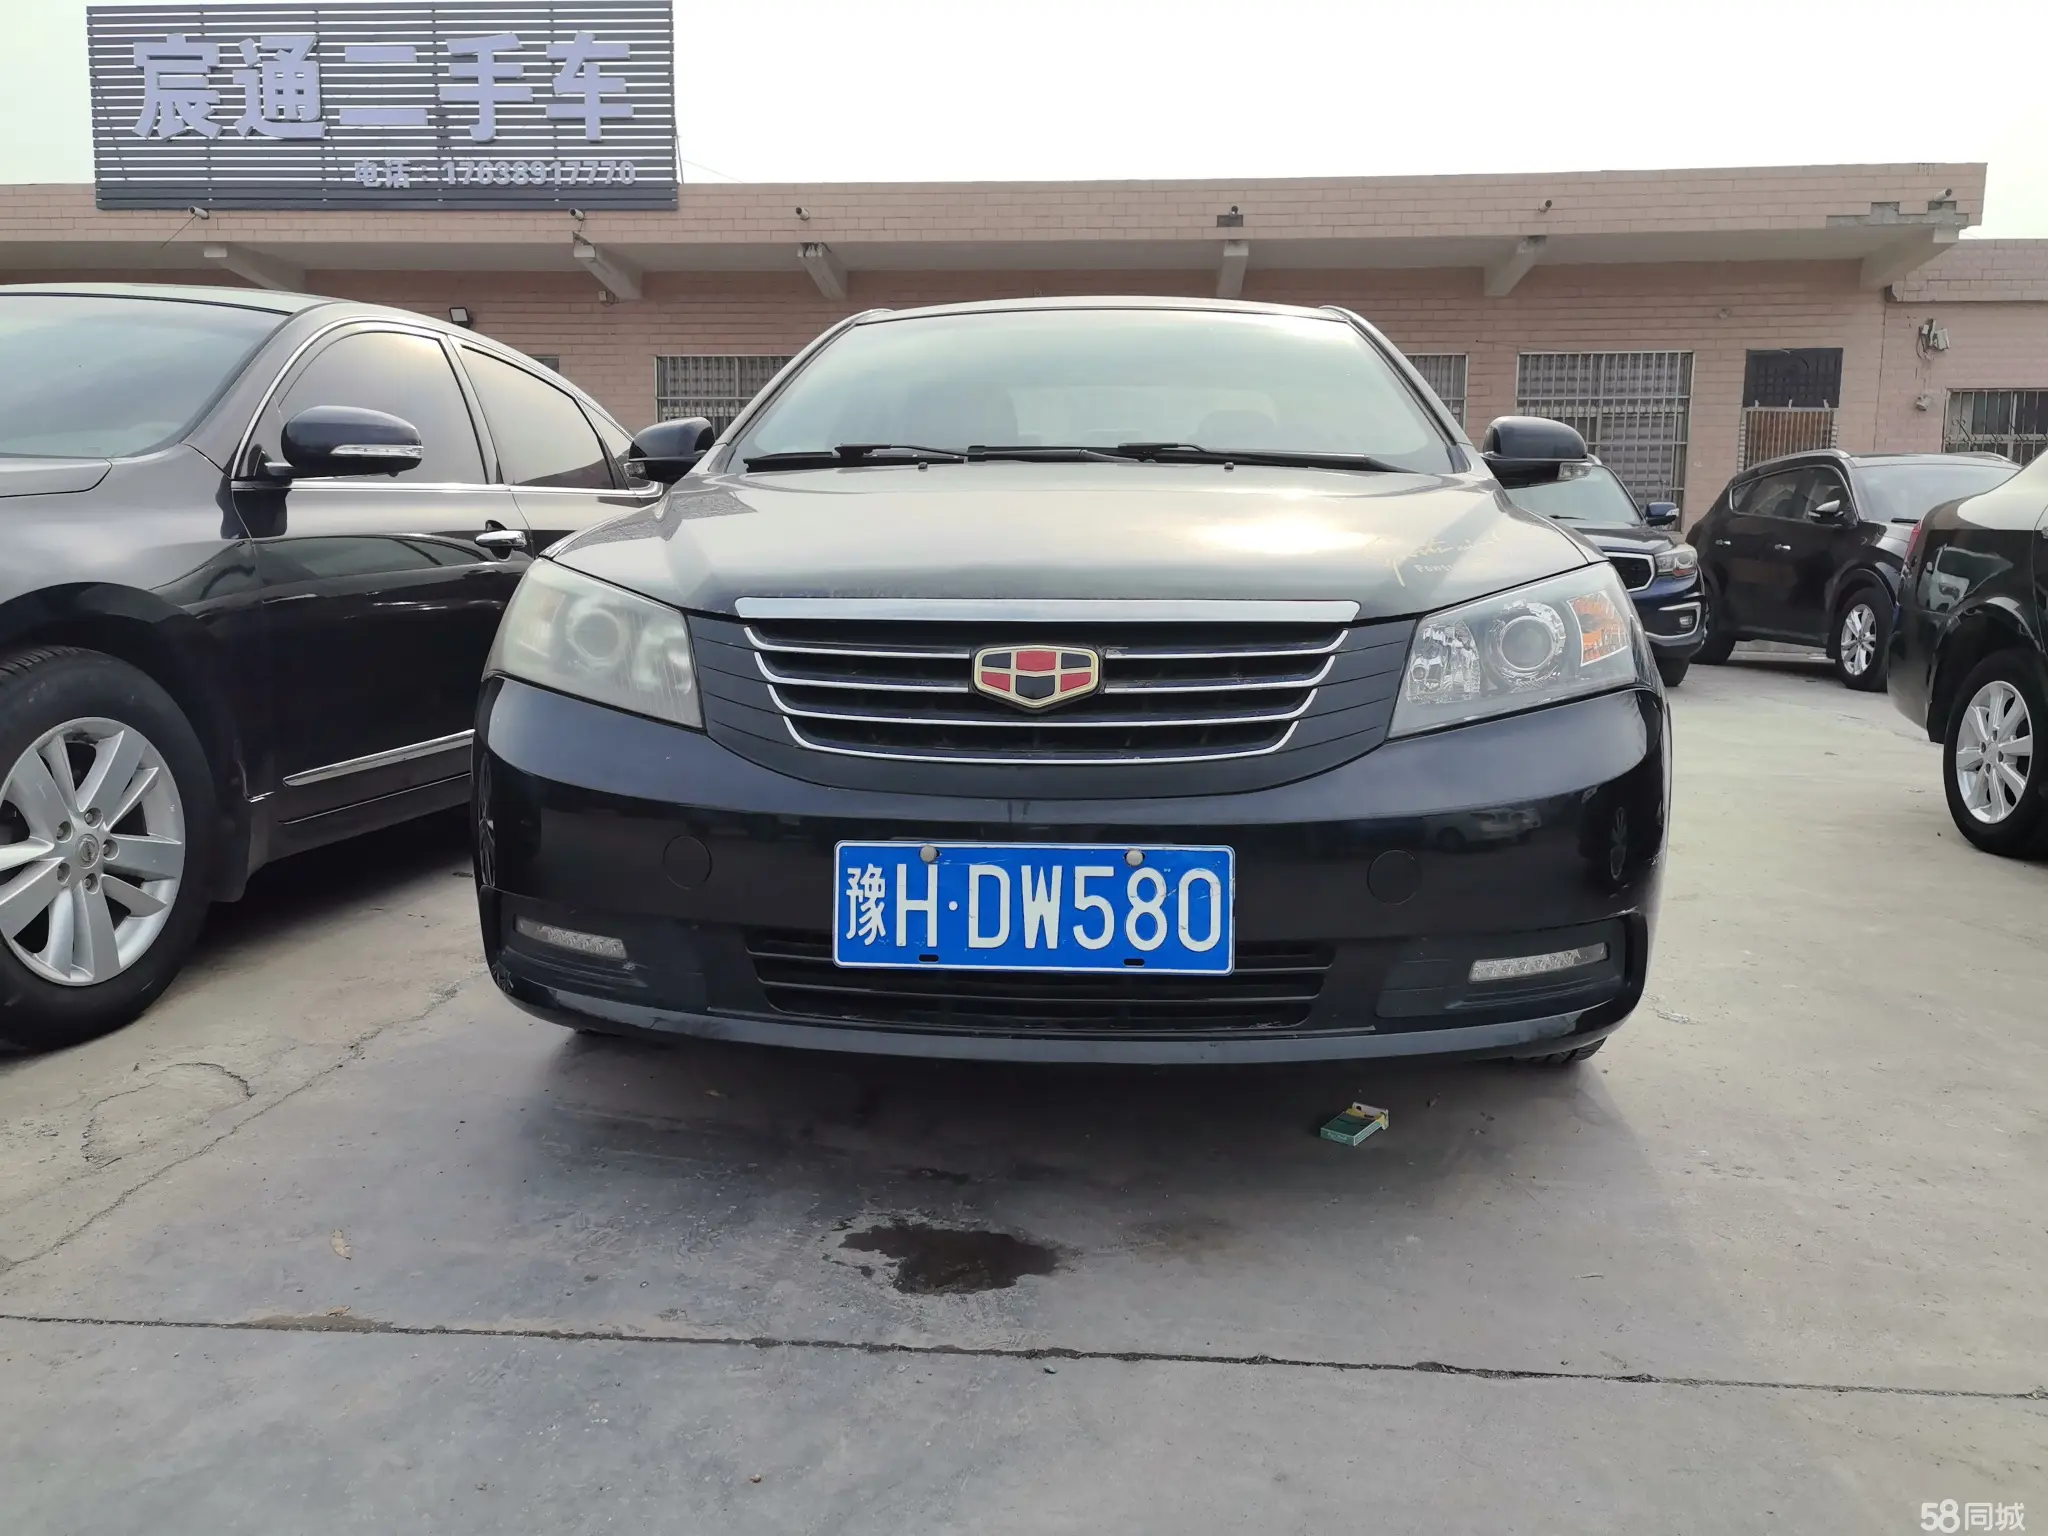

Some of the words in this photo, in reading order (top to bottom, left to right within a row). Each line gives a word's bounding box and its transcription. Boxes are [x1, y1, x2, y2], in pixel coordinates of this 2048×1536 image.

[132, 32, 634, 143] 宸通二手车
